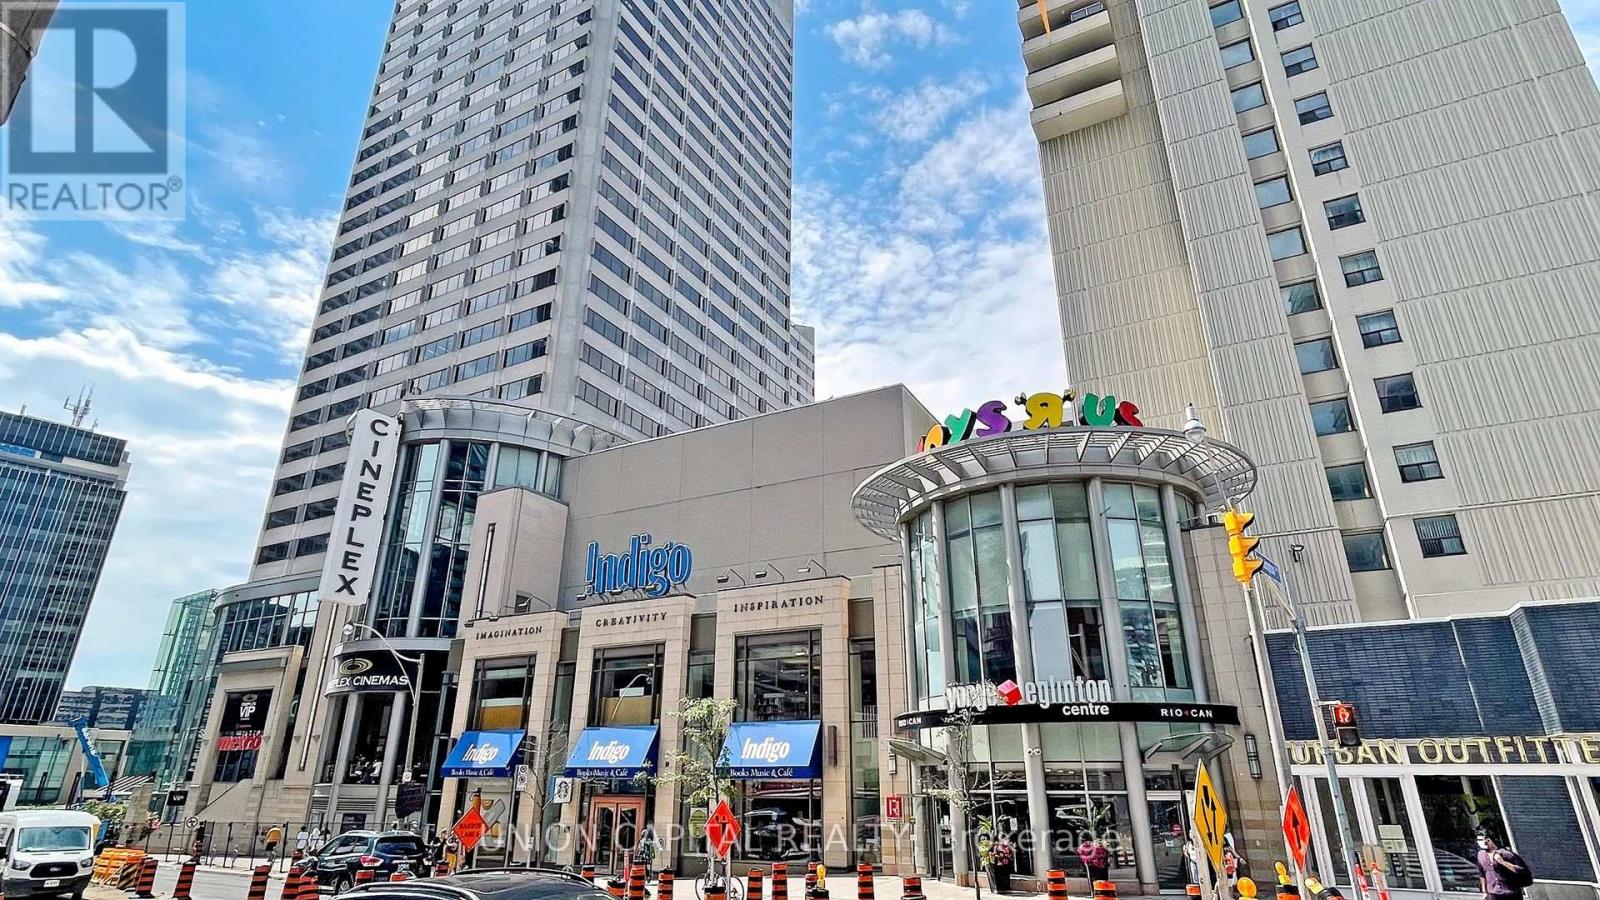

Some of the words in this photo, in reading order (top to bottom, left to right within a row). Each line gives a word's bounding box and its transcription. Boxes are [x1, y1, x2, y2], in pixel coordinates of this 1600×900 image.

[335, 418, 390, 596] CINEPLEX
[584, 533, 694, 598] Indigo
[733, 595, 824, 613] INSPIRATION
[595, 611, 668, 628] CREATIVITY
[475, 625, 543, 641] IMAGINATION
[352, 675, 410, 686] CINEMAS
[1062, 703, 1110, 716] centre
[462, 743, 499, 764] Indigo
[587, 740, 631, 764] Indigo
[740, 737, 790, 763] Indigo
[730, 767, 750, 777] Books
[750, 768, 770, 777] Music
